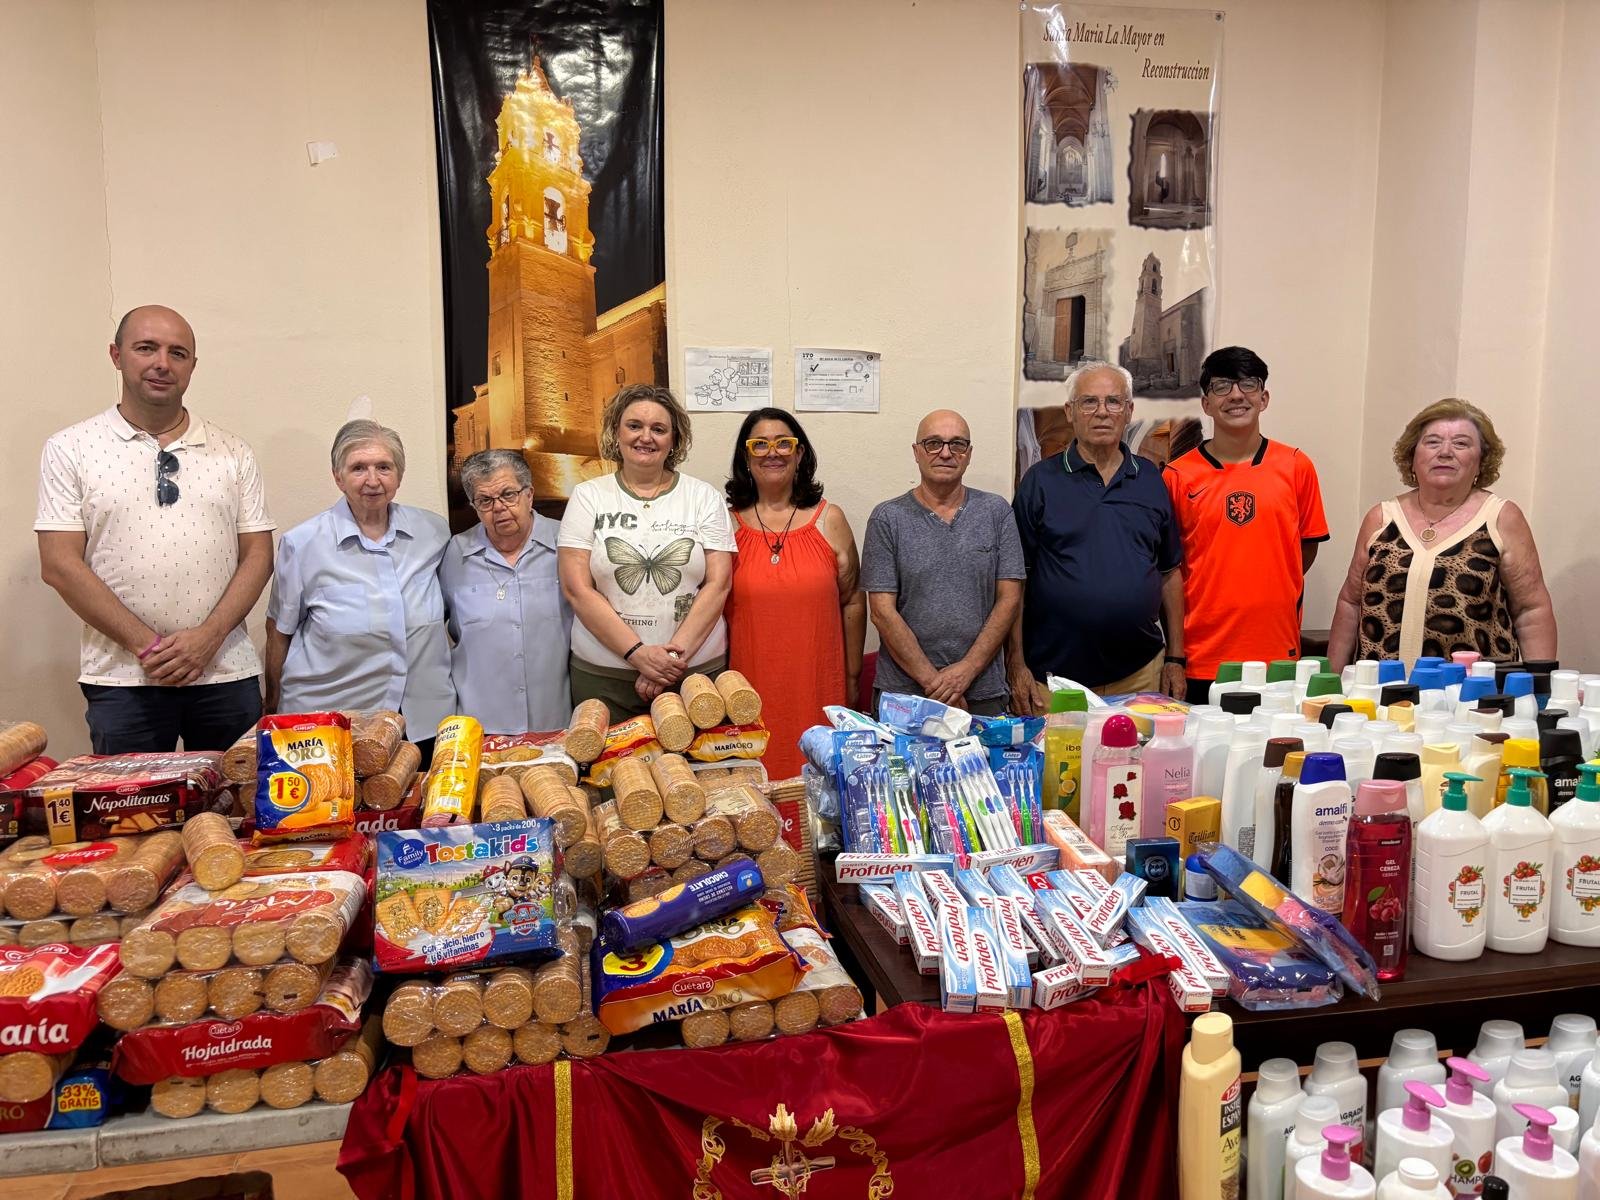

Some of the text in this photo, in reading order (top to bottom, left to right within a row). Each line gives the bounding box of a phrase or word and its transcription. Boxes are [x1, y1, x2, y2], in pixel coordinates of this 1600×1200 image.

[1073, 22, 1103, 44] Maria
[1105, 24, 1118, 45] La
[1120, 25, 1152, 52] Mayor
[1153, 31, 1165, 46] en
[1142, 58, 1209, 80] Reconstruccion
[595, 512, 638, 530] NYC
[287, 737, 323, 751] MARÍA
[714, 743, 736, 751] MARÍA
[286, 746, 325, 764] ORO
[1164, 767, 1191, 779] Nelia
[84, 793, 171, 813] Napolitanas
[1315, 803, 1348, 816] amalfi
[522, 820, 537, 829] 200
[398, 849, 425, 864] Family
[425, 833, 540, 864] Tostakids
[840, 863, 912, 879] Profidén
[689, 871, 728, 892] CHOCOLATE
[1091, 889, 1121, 932] Profidén
[906, 898, 943, 953] Profidén
[944, 903, 969, 962] Profidén
[997, 897, 1023, 950] Profidén
[462, 931, 486, 944] hierro
[1055, 911, 1105, 963] Profidén
[443, 942, 480, 959] vitaminas
[1167, 920, 1224, 974] Profidén
[974, 932, 1002, 991] Profidén
[674, 979, 712, 992] Cuétara
[653, 990, 744, 1023] MARÍA ORO
[0, 1018, 70, 1046] aría
[210, 1024, 241, 1035] Cuétara
[181, 1035, 273, 1061] Hojaldrada
[62, 1084, 97, 1099] 33%
[0, 1104, 25, 1119] RO
[60, 1097, 100, 1110] GRATIS
